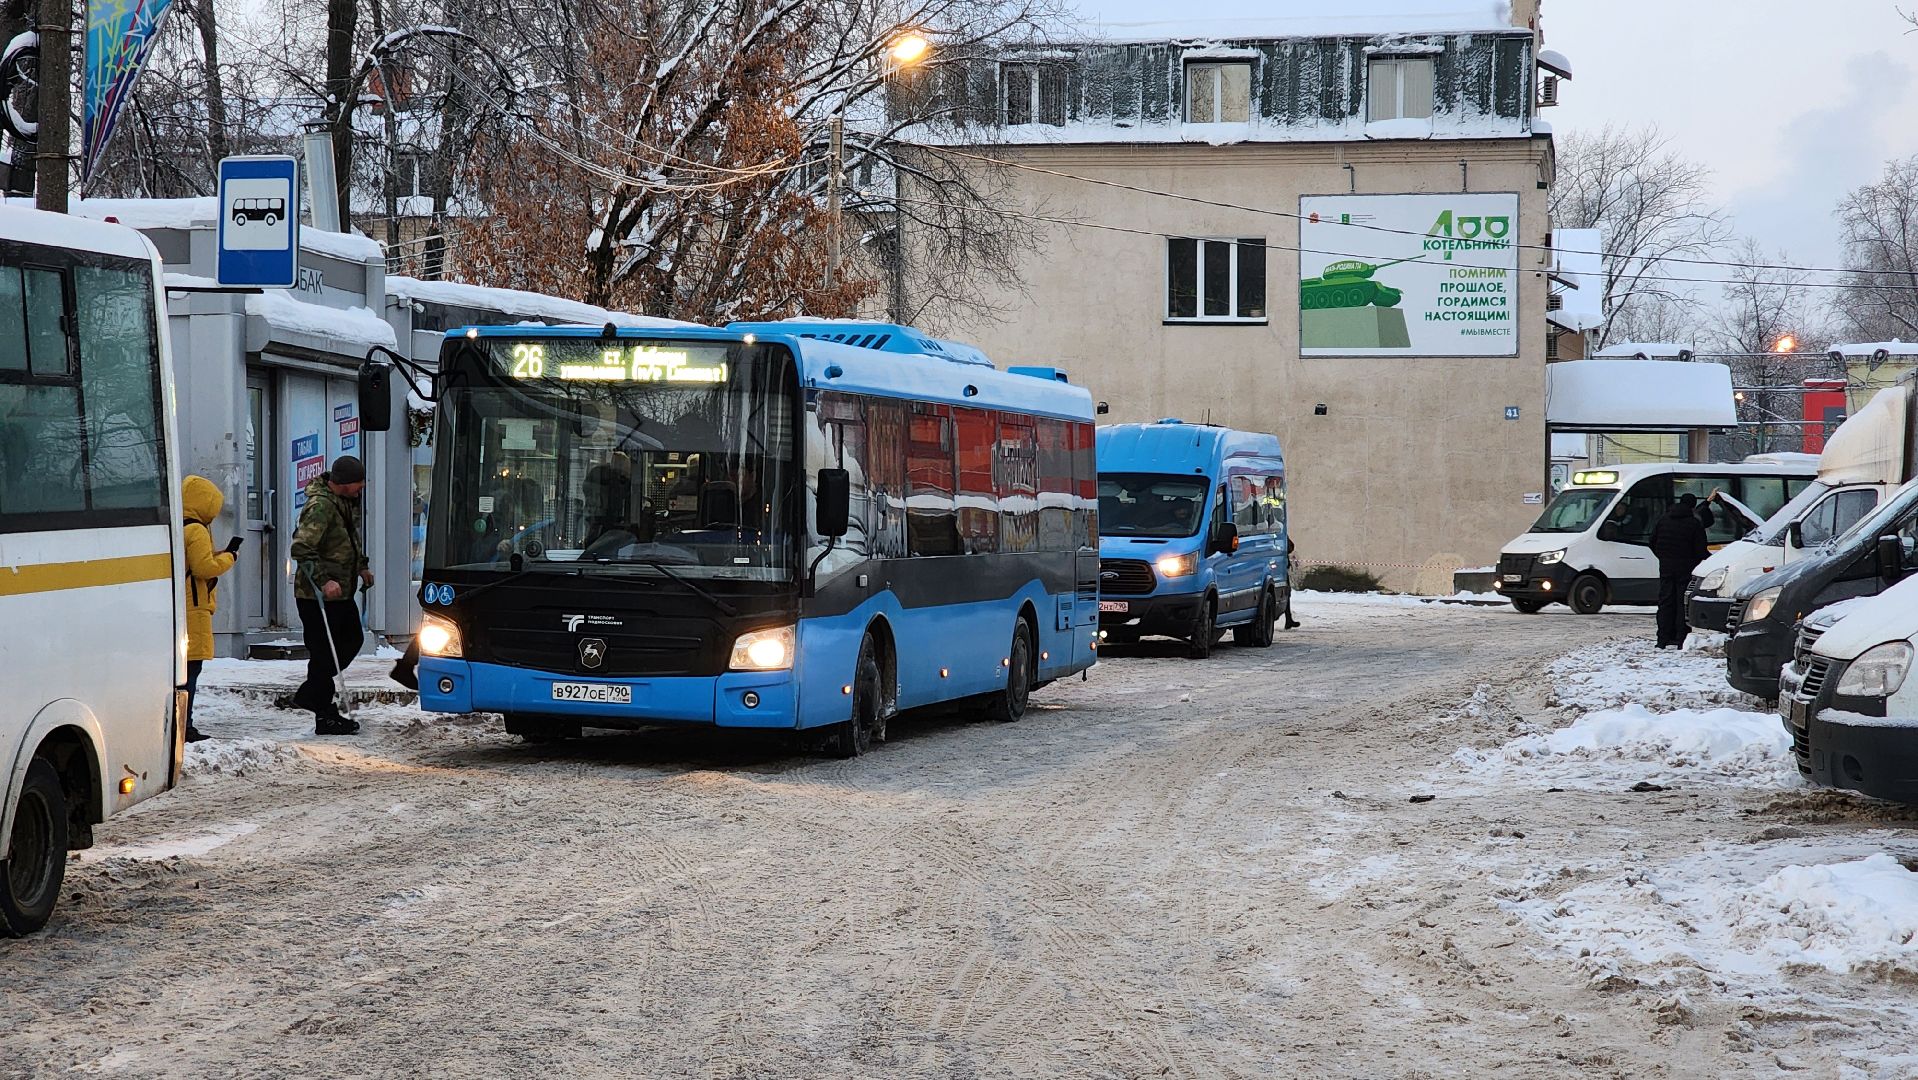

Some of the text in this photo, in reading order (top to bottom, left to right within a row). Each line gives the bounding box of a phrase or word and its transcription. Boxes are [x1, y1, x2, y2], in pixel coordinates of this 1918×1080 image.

[1423, 239, 1510, 250] КОТЕЛЬНИКИ
[1449, 268, 1507, 278] ПОМНИМ
[298, 269, 323, 295] БАК
[1440, 282, 1507, 293] ПРОШЛОЕ,
[1437, 296, 1506, 307] ГОРДИМСЯ
[1460, 327, 1511, 336] #МЫВМЕСТЕ
[514, 345, 543, 377] 26
[1506, 408, 1518, 418] 41
[297, 439, 313, 457] ТАБАК
[298, 461, 324, 483] СИГАРЕТЫ
[1099, 602, 1113, 611] 2НХ
[609, 686, 627, 698] 790
